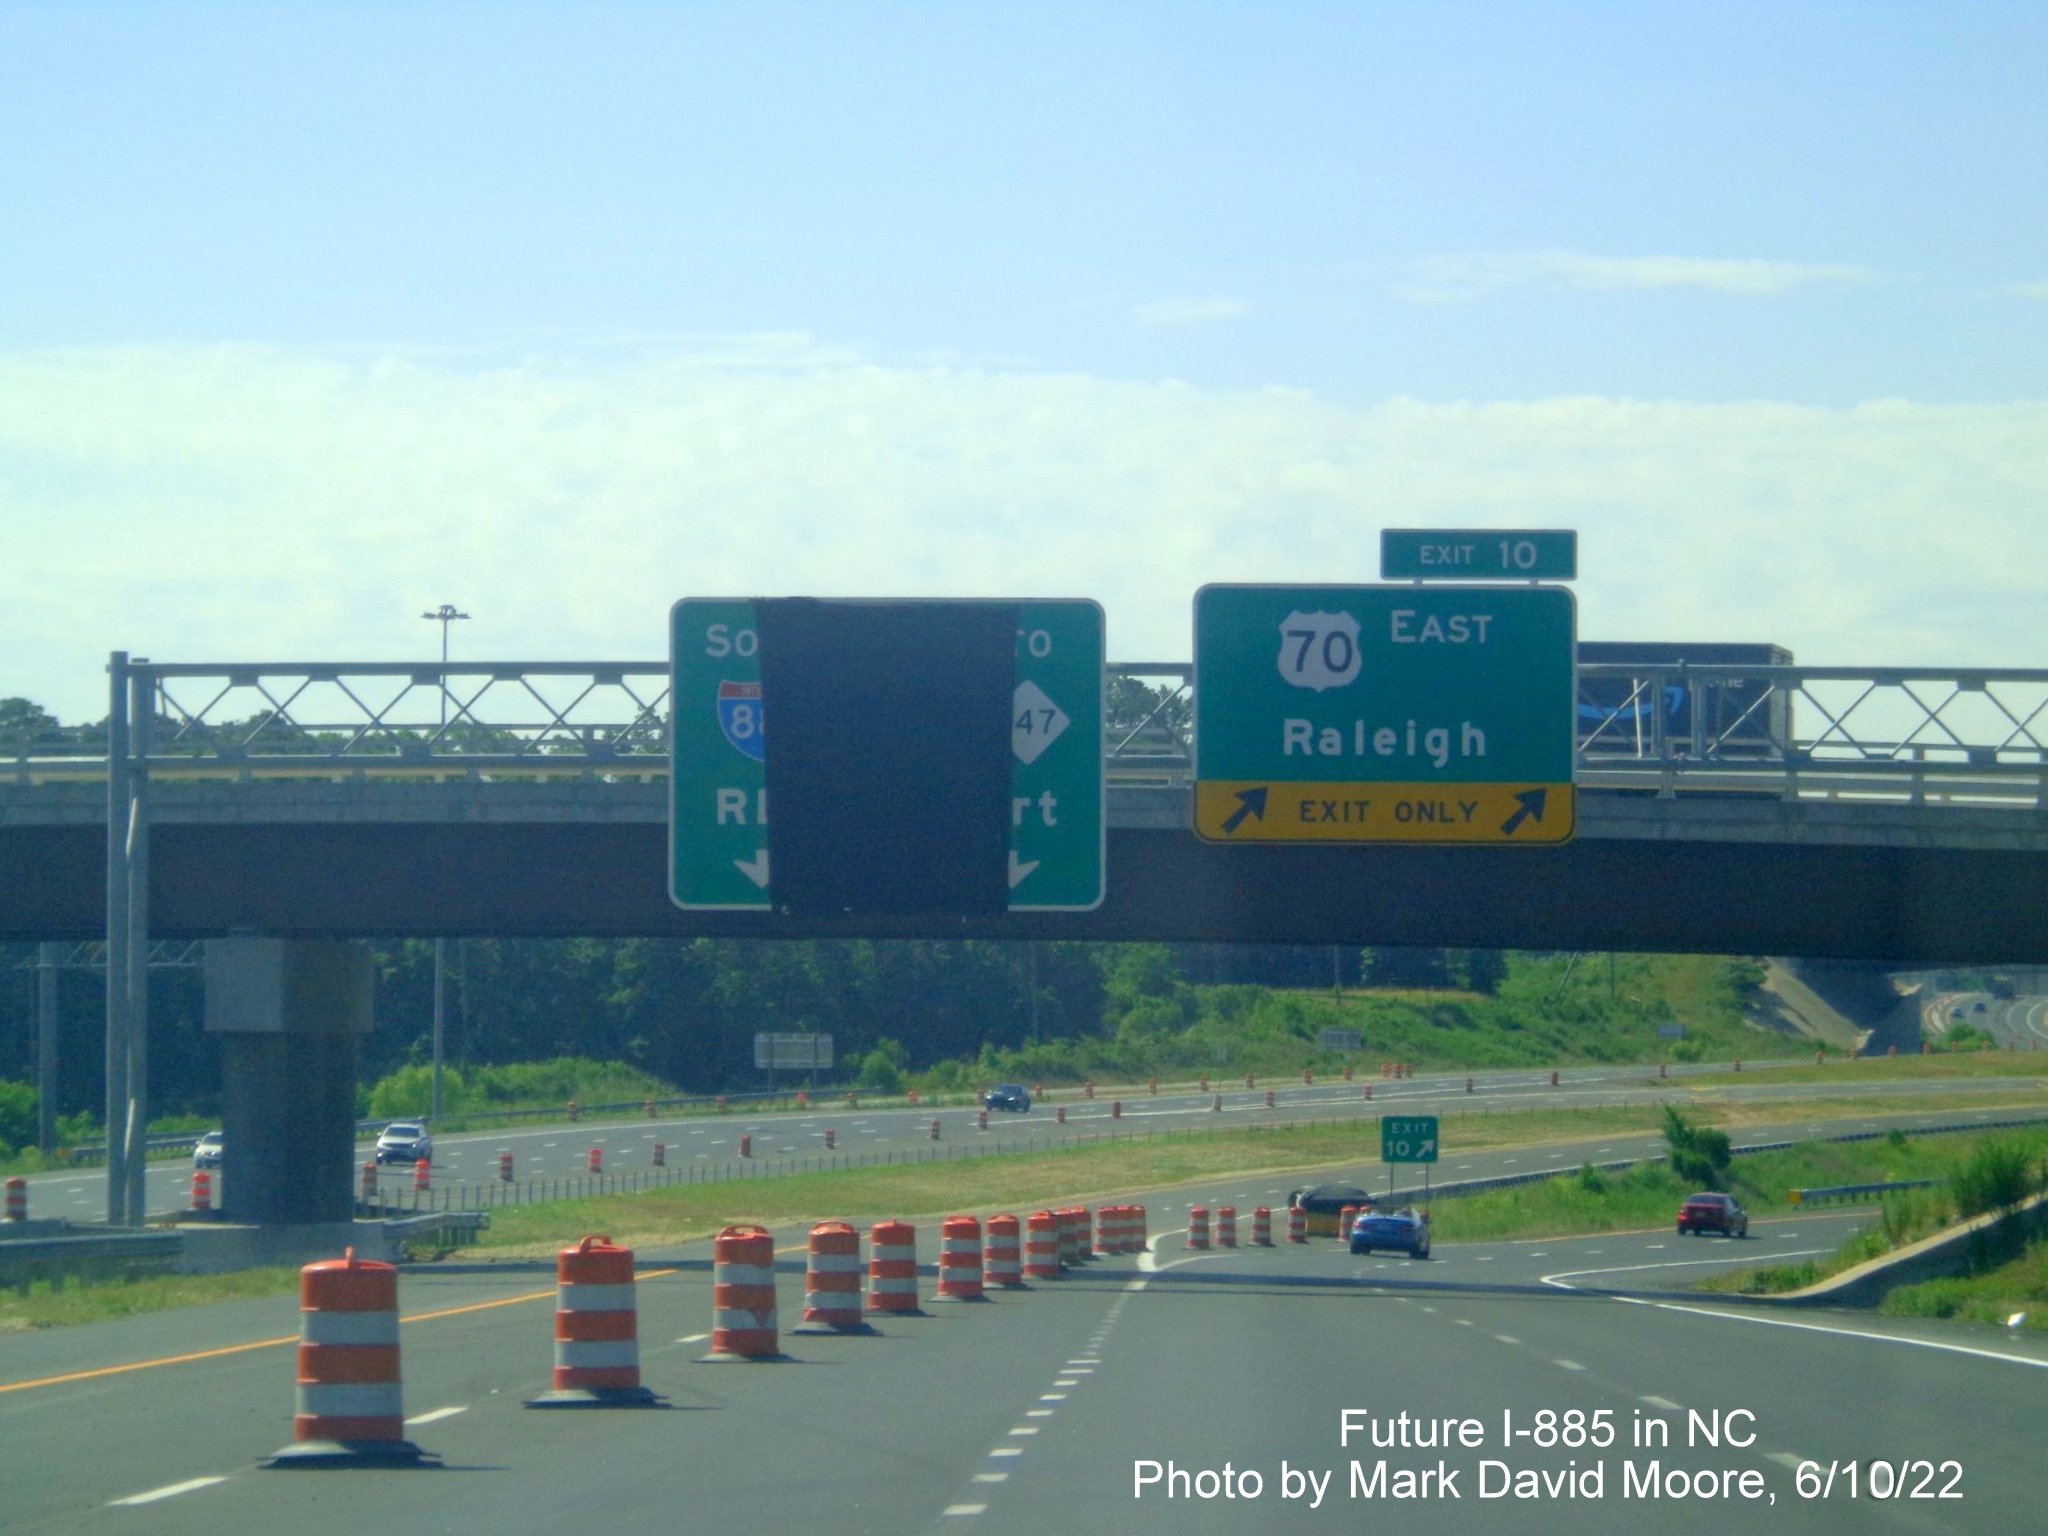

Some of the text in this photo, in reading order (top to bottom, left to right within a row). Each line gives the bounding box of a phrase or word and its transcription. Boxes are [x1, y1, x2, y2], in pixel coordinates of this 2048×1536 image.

[1421, 541, 1537, 569] EXIT 10
[1391, 609, 1493, 644] EAST
[1287, 630, 1354, 674] 70
[1015, 709, 1056, 735] 47
[1283, 718, 1486, 769] Raleigh
[1012, 790, 1058, 827] rt
[1300, 801, 1479, 824] EXIT ONLY
[1391, 1122, 1429, 1134] EXIT
[1386, 1140, 1410, 1157] 10
